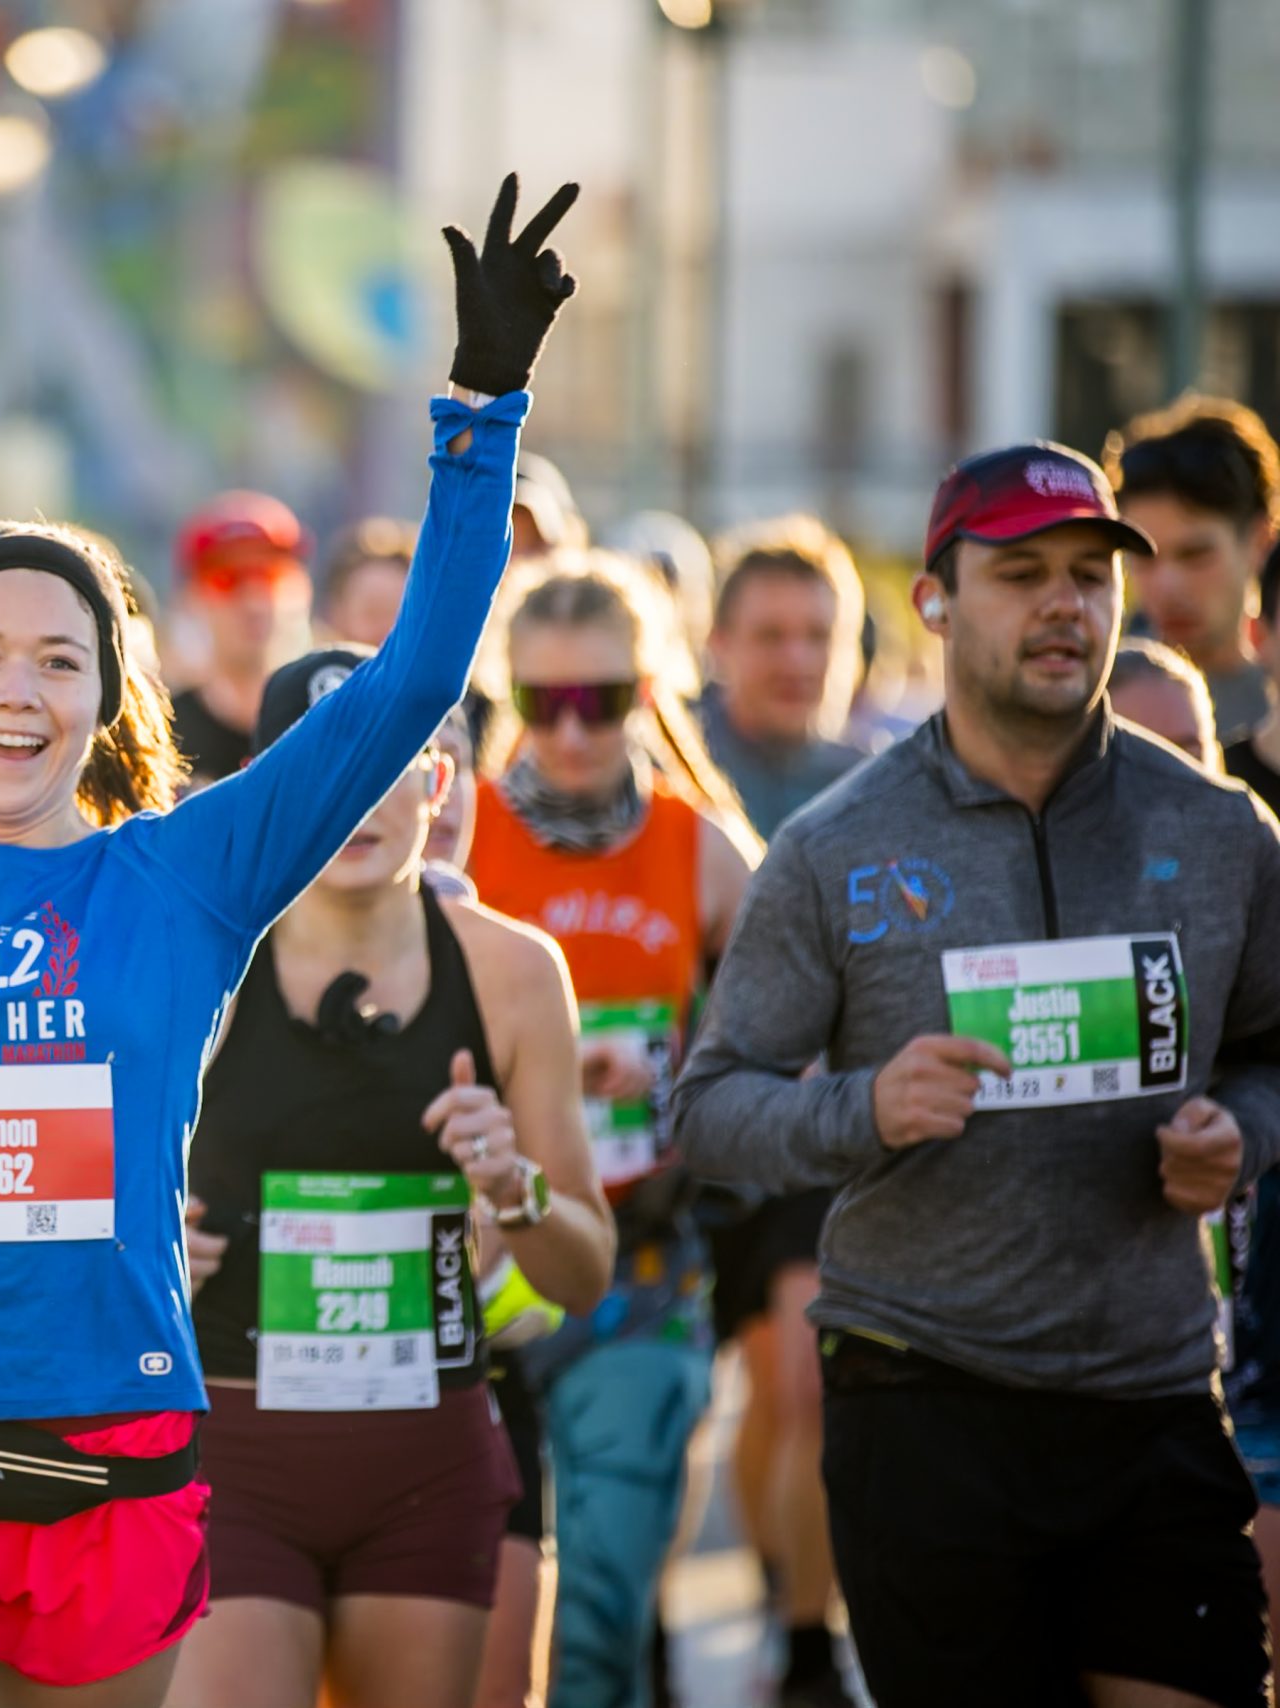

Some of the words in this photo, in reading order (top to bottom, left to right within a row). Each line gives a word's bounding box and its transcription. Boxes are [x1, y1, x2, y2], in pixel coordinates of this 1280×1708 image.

[1008, 986, 1081, 1022] Justin
[1142, 953, 1178, 1074] BLACK
[1, 1042, 87, 1064] MARATHON
[1011, 1022, 1081, 1066] 3551
[435, 1226, 465, 1346] BLACK
